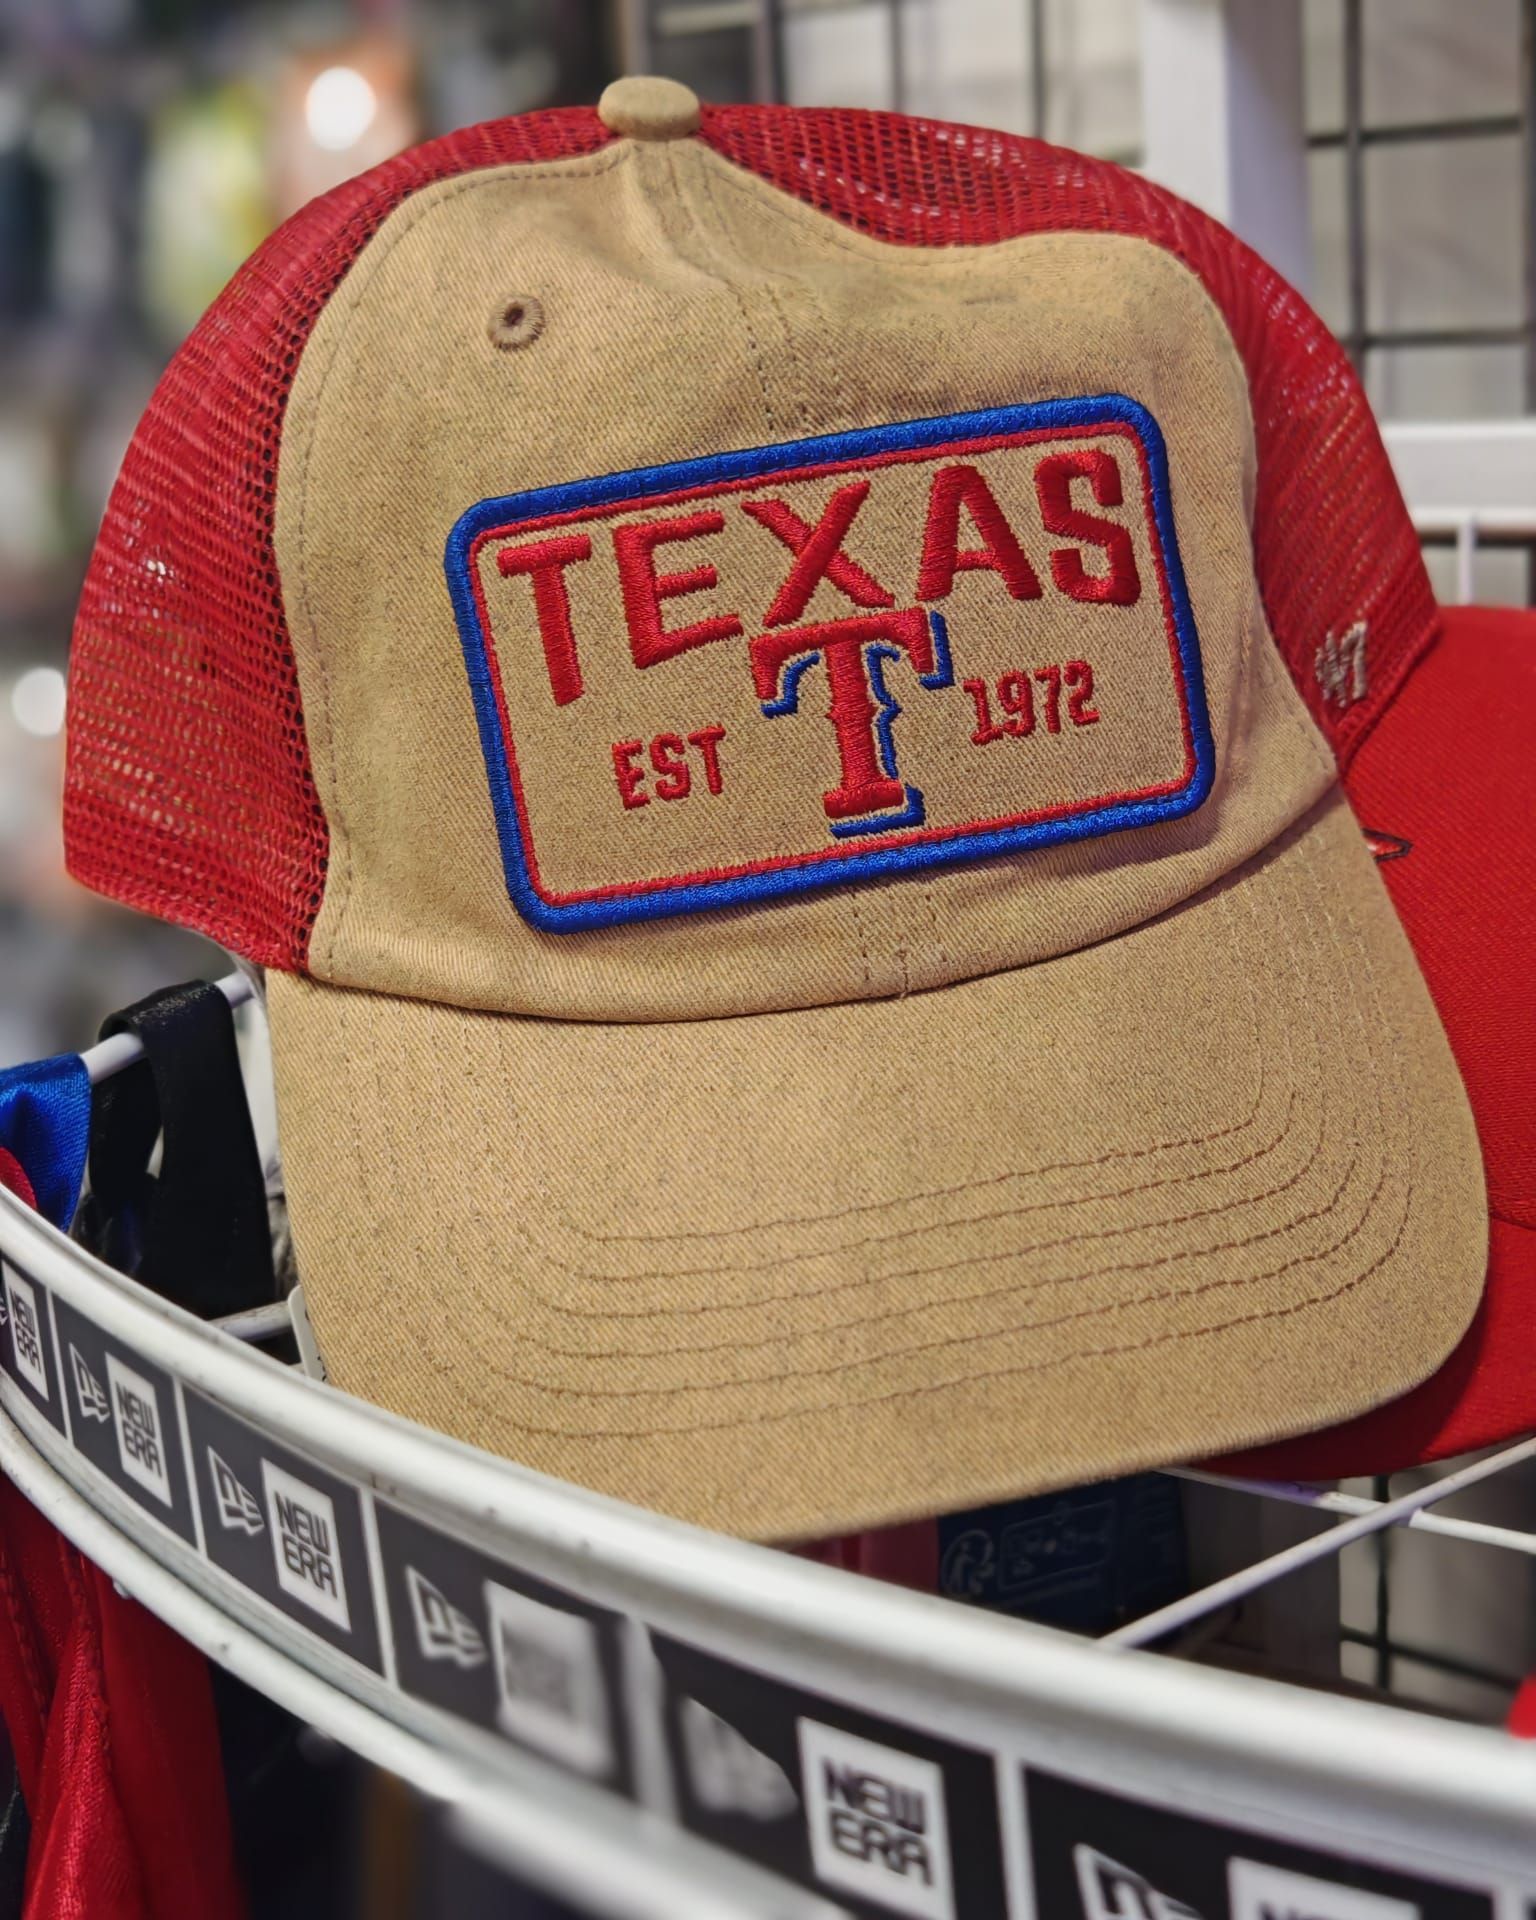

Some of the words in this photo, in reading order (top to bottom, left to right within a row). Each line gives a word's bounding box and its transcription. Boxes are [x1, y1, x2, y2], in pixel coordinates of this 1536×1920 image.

[498, 449, 1142, 707] TEXAS
[962, 660, 1100, 746] 1972
[611, 726, 726, 811] EST
[15, 1320, 42, 1374] ERA
[115, 1381, 156, 1440] NEW
[121, 1419, 163, 1479] ERA
[273, 1491, 331, 1557] NEW
[282, 1531, 338, 1600] ERA
[821, 1757, 926, 1836] NEW
[829, 1805, 934, 1888] ERA
